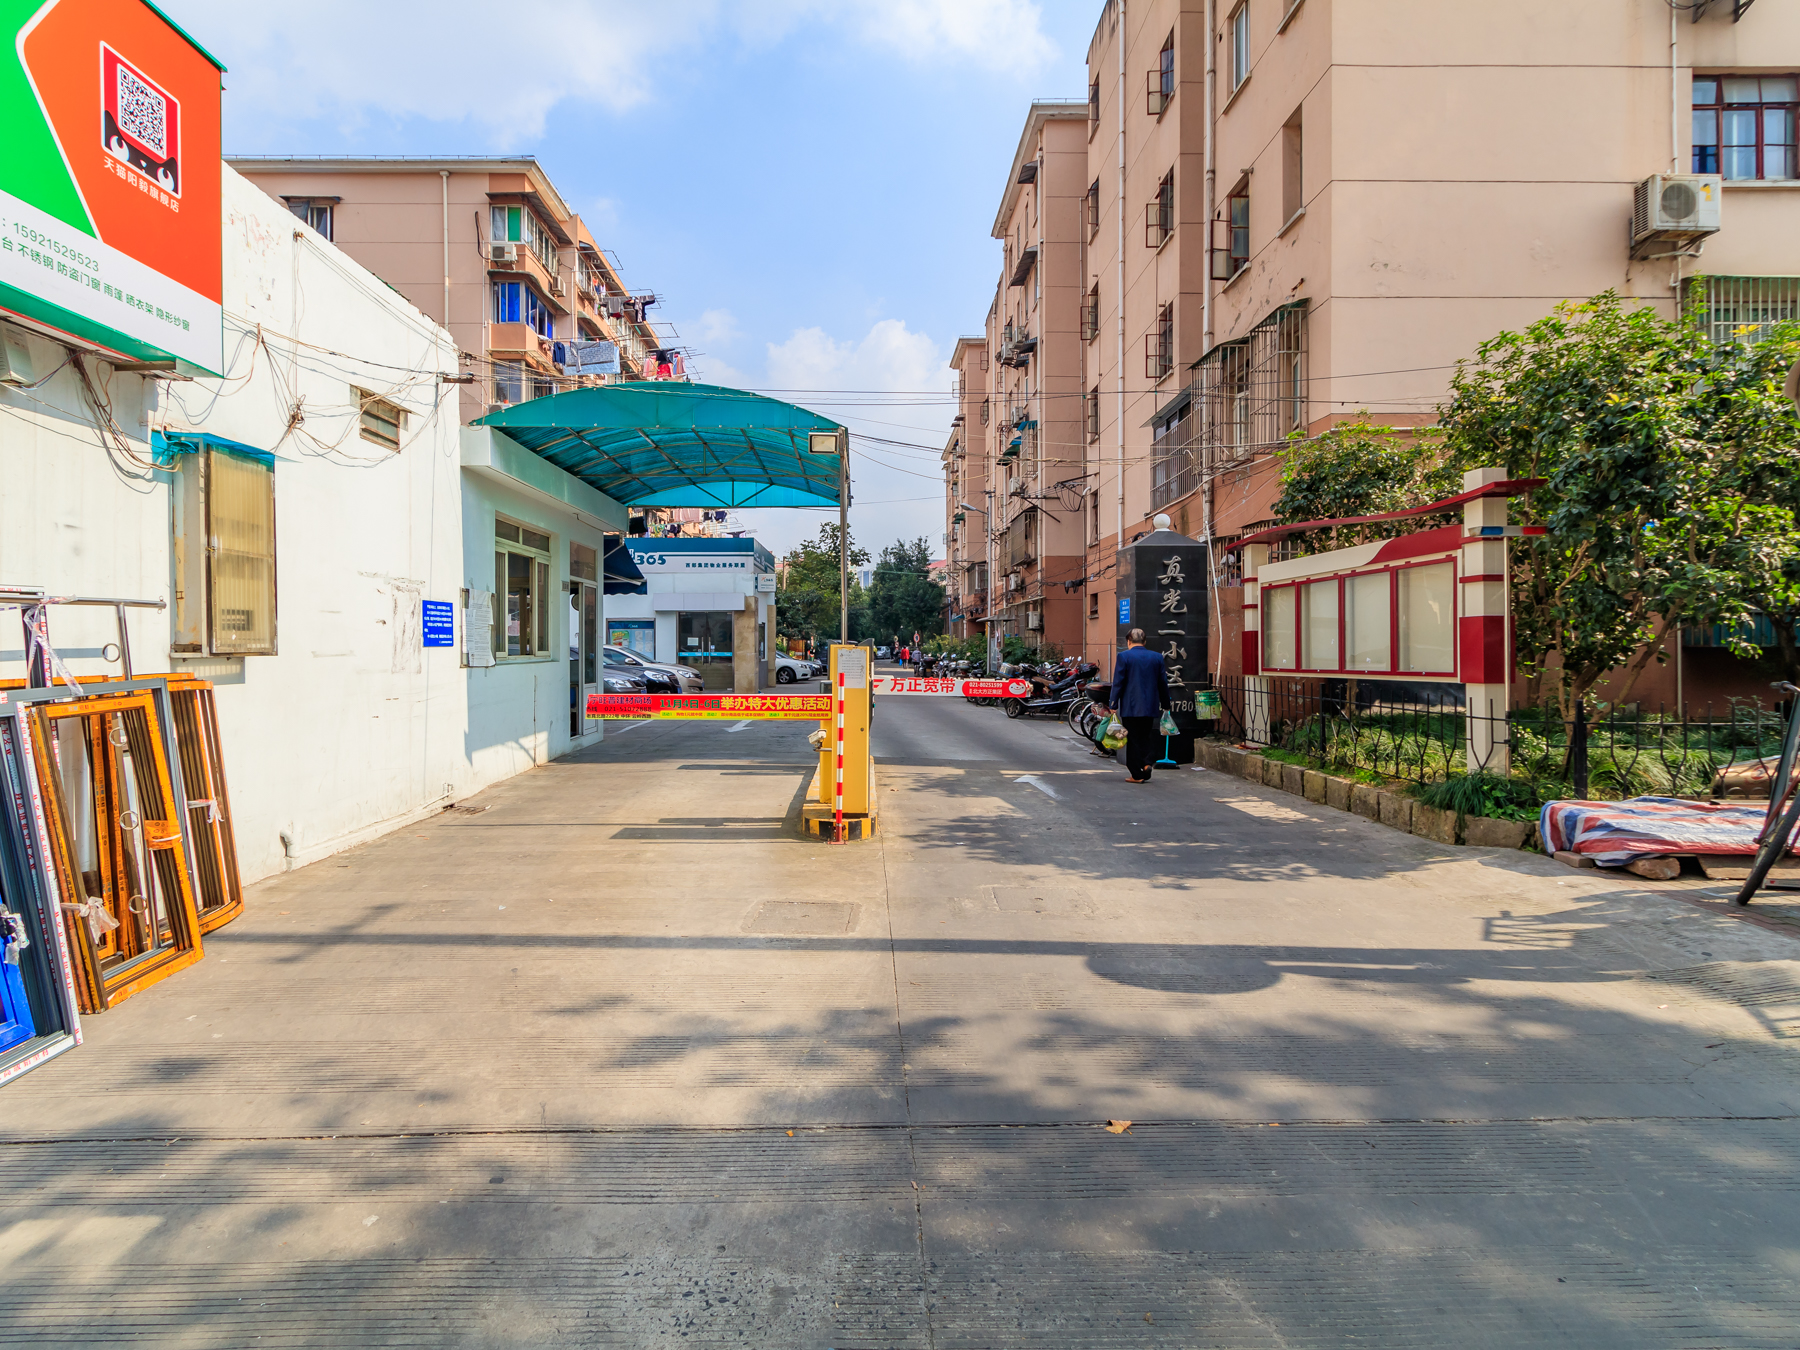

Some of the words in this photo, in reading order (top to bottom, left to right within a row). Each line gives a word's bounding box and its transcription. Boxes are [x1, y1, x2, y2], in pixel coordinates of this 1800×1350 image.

[103, 156, 180, 214] 天猫阳毅旗舰店
[13, 222, 100, 273] 15921529523
[17, 242, 54, 270] 不锈钢
[57, 260, 101, 292] 防盗门窗
[125, 293, 155, 315] 晒衣架
[155, 306, 190, 332] 隐形纱窗
[890, 677, 956, 693] 方正宽带
